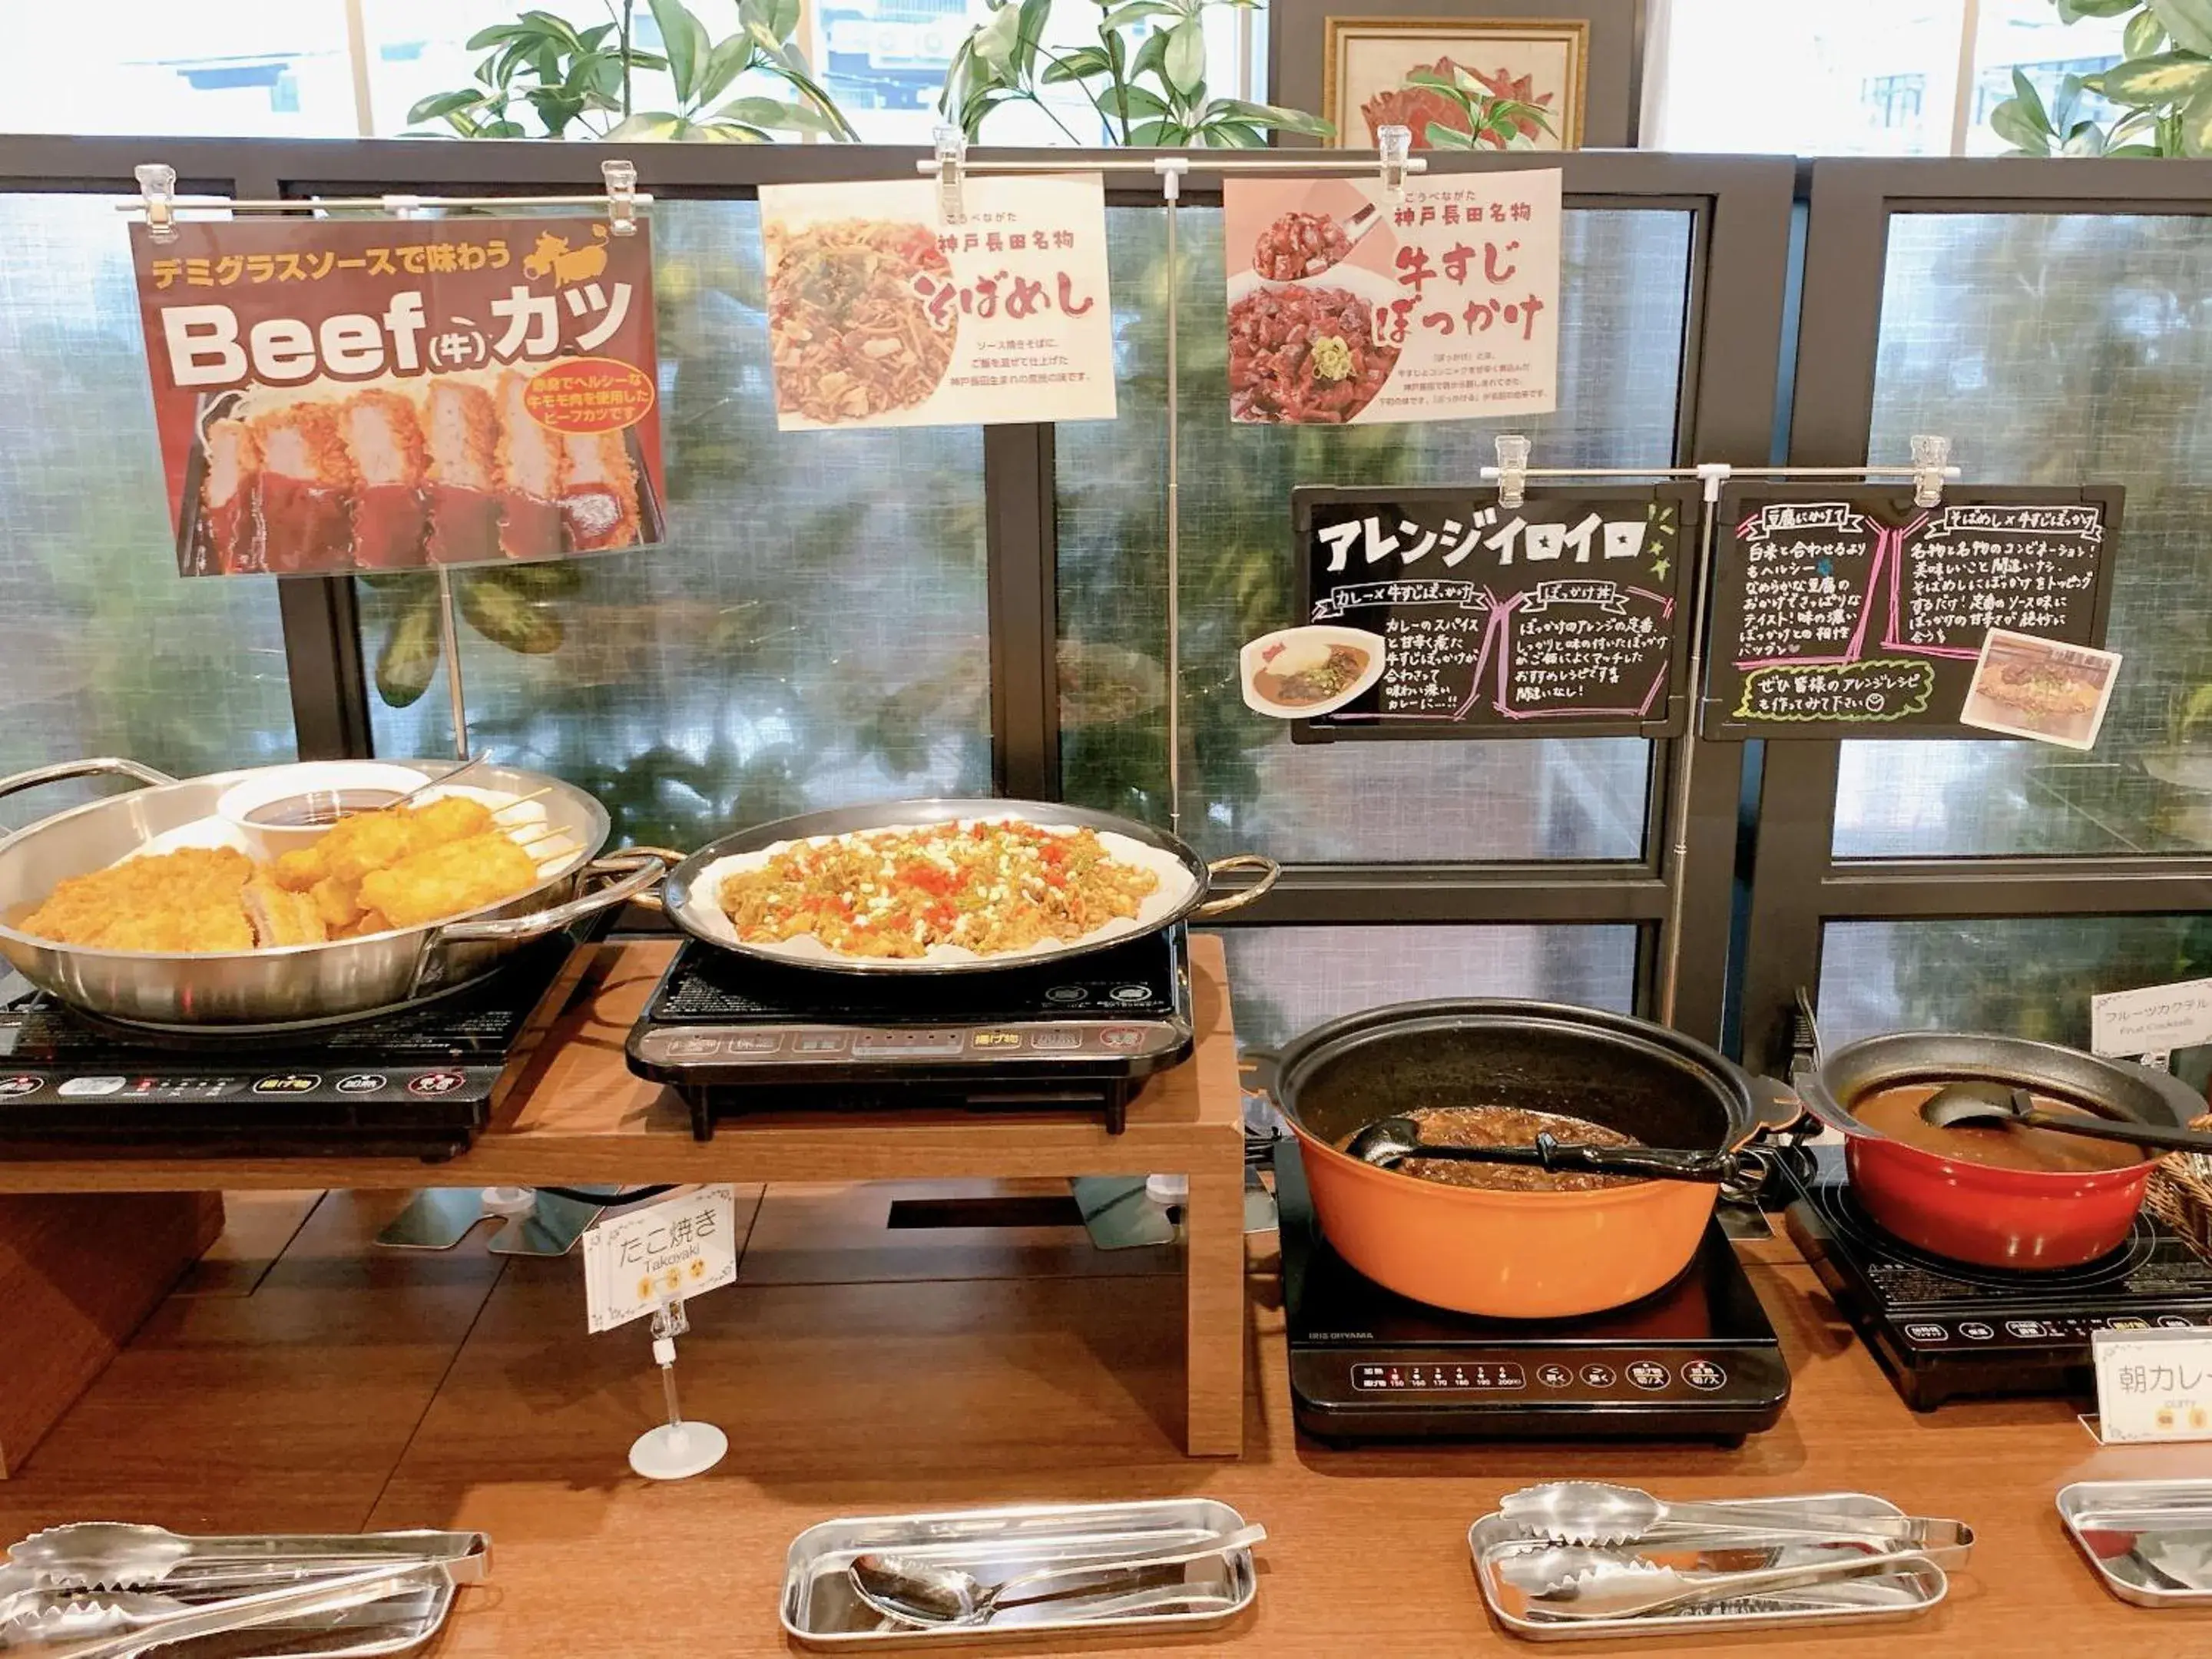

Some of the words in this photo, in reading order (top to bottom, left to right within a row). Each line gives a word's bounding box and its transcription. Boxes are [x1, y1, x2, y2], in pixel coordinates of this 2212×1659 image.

[1394, 202, 1532, 227] 神戸長田名物
[938, 230, 1075, 253] 神戸長田名物
[153, 240, 511, 290] デミグラスソースで味わう
[1396, 240, 1520, 291] 牛すじ
[912, 270, 1094, 328] そばめし
[1375, 293, 1544, 343] ぼっかけ
[1767, 508, 1844, 527] 豆腐にかけて
[1318, 505, 1647, 573] アレンジイロイロ
[1749, 541, 1866, 561] 白米と合わせるより
[1747, 561, 1816, 579] もヘルシー
[1544, 583, 1611, 601] ぼっかけ丼
[1745, 576, 1850, 595] なめらかな豆腐の
[1912, 571, 2094, 595] そばめしにぼっかけをトッピング
[1743, 592, 1861, 611] おかげでさっぱりな
[1386, 617, 1479, 634] カレーのスパイス
[1740, 625, 1850, 643] ぼっかけとの相性
[1386, 634, 1464, 651] と甘辛く煮た
[1516, 634, 1669, 654] しっかりと味の付いたぼっかけ
[1385, 649, 1479, 667] 牛すじぼっかけが
[1515, 651, 1644, 666] がご飯によくマッチした
[1384, 669, 1440, 683] 合わさって
[1757, 674, 1921, 694] ぜひ皆様のアレンジレシピ
[1386, 684, 1451, 698] 味わい深い
[1758, 694, 1863, 713] も作ってみて下さい
[2105, 998, 2208, 1023] フルーツカクテル
[619, 1207, 717, 1268] たこ焼き
[643, 1242, 700, 1273] Takoyaki
[2118, 1363, 2212, 1394] 朝カレ
